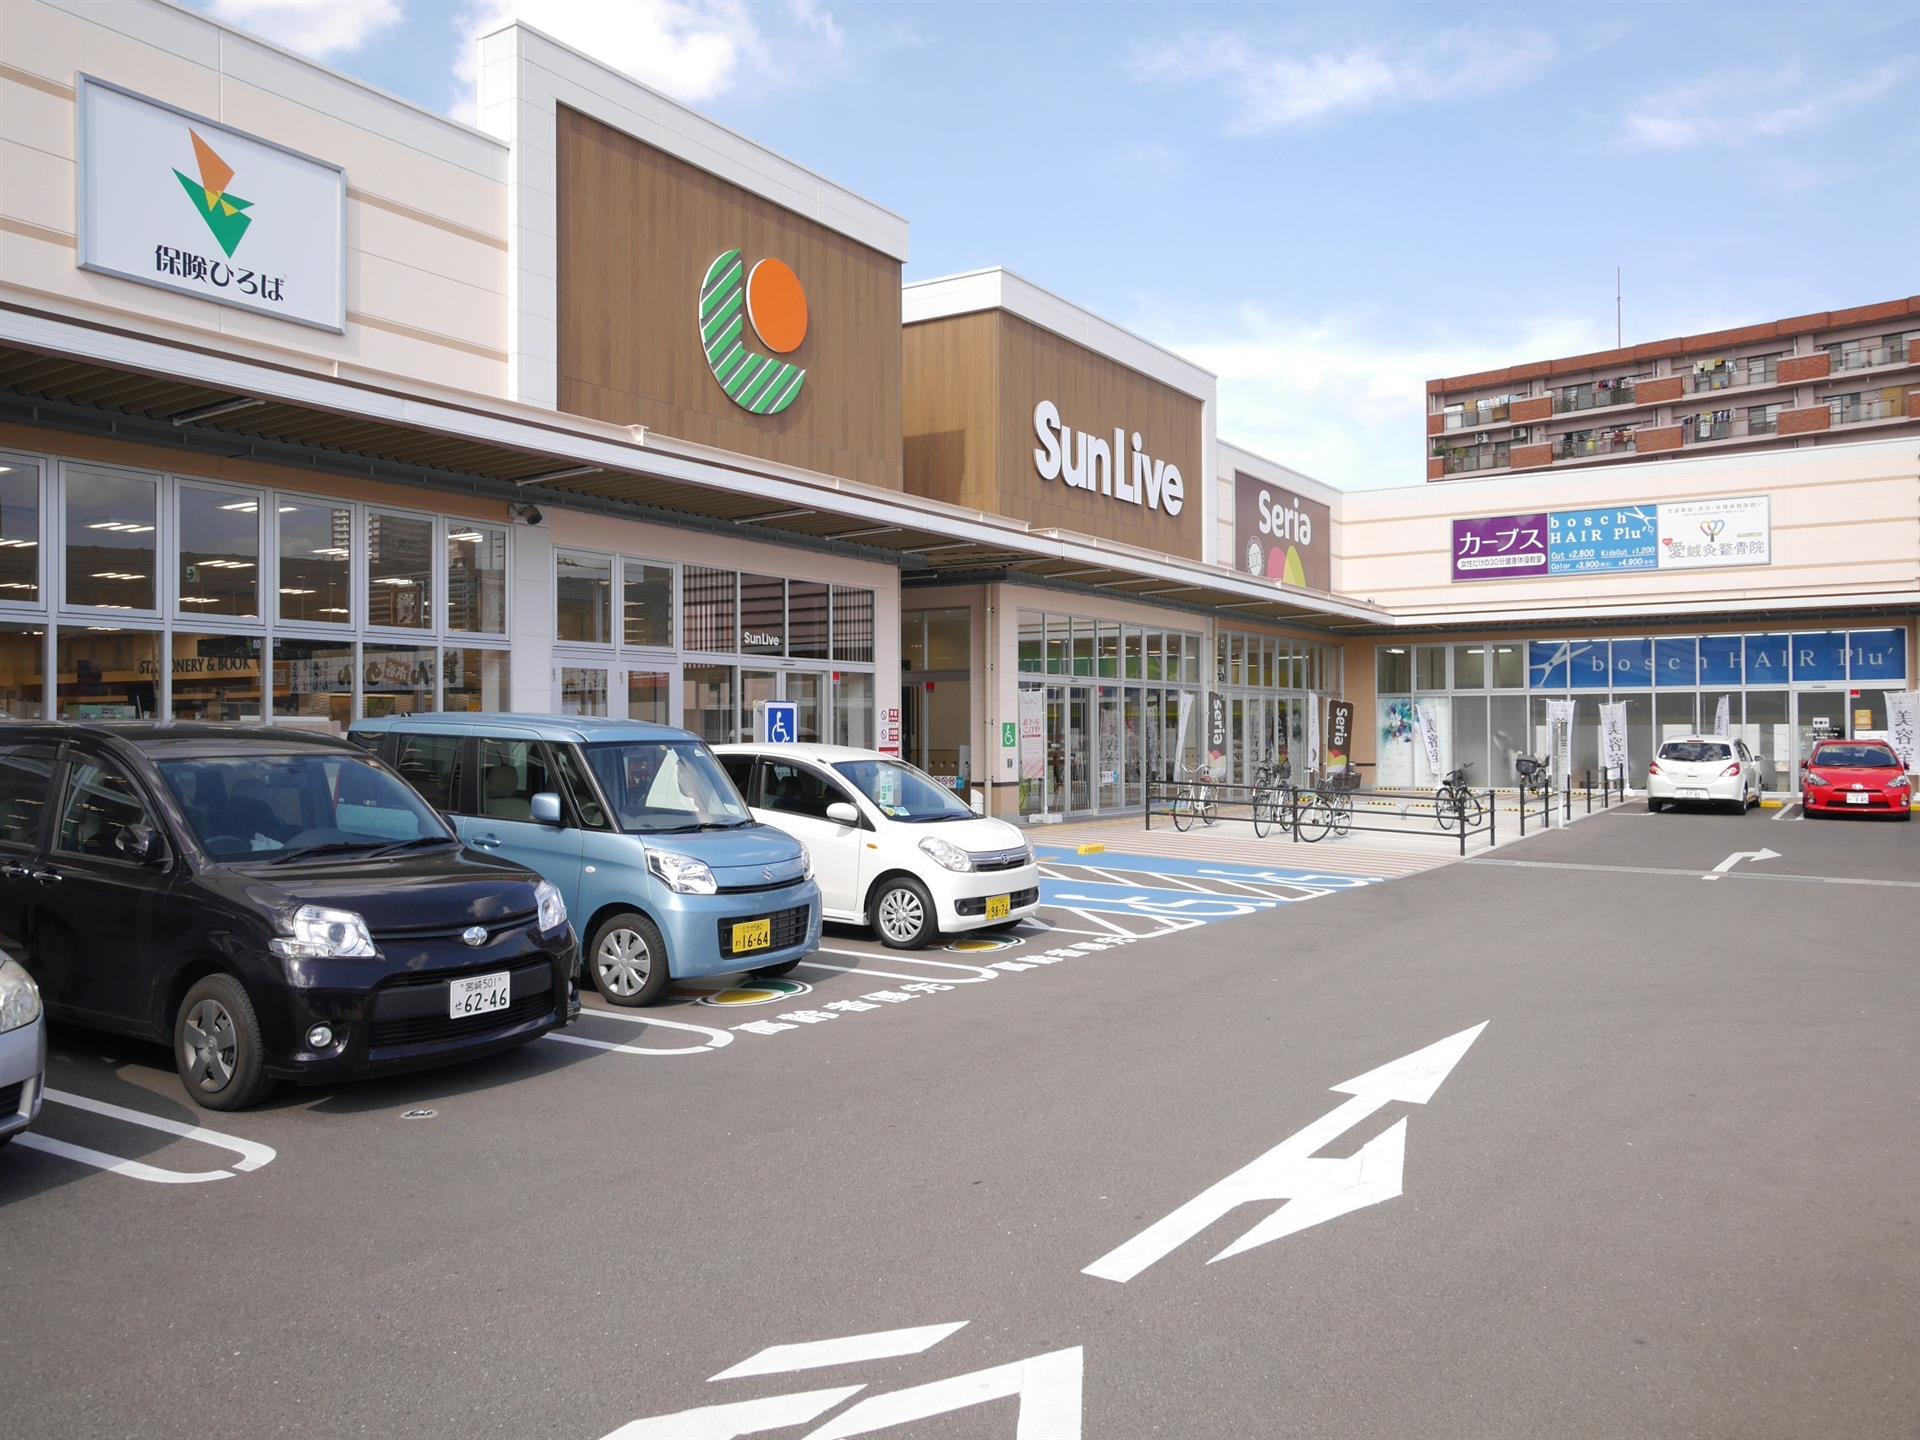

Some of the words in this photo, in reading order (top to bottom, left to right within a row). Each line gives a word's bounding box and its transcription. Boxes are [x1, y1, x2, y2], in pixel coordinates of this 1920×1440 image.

[155, 243, 285, 302] 保険ひろば
[1033, 400, 1184, 516] SunLive
[1258, 489, 1312, 546] Seria
[1551, 512, 1627, 529] bosch
[1458, 527, 1544, 556] カーブス
[1551, 529, 1602, 544] HAIR
[743, 631, 780, 647] SunLive
[207, 657, 215, 671] &
[218, 656, 251, 671] BOOK
[1592, 654, 1708, 672] bosch
[1728, 648, 1816, 669] HAIR
[1212, 699, 1226, 746] Seria
[1334, 707, 1348, 746] Seria
[743, 930, 768, 949] 16-64
[464, 988, 507, 1013] 62-46
